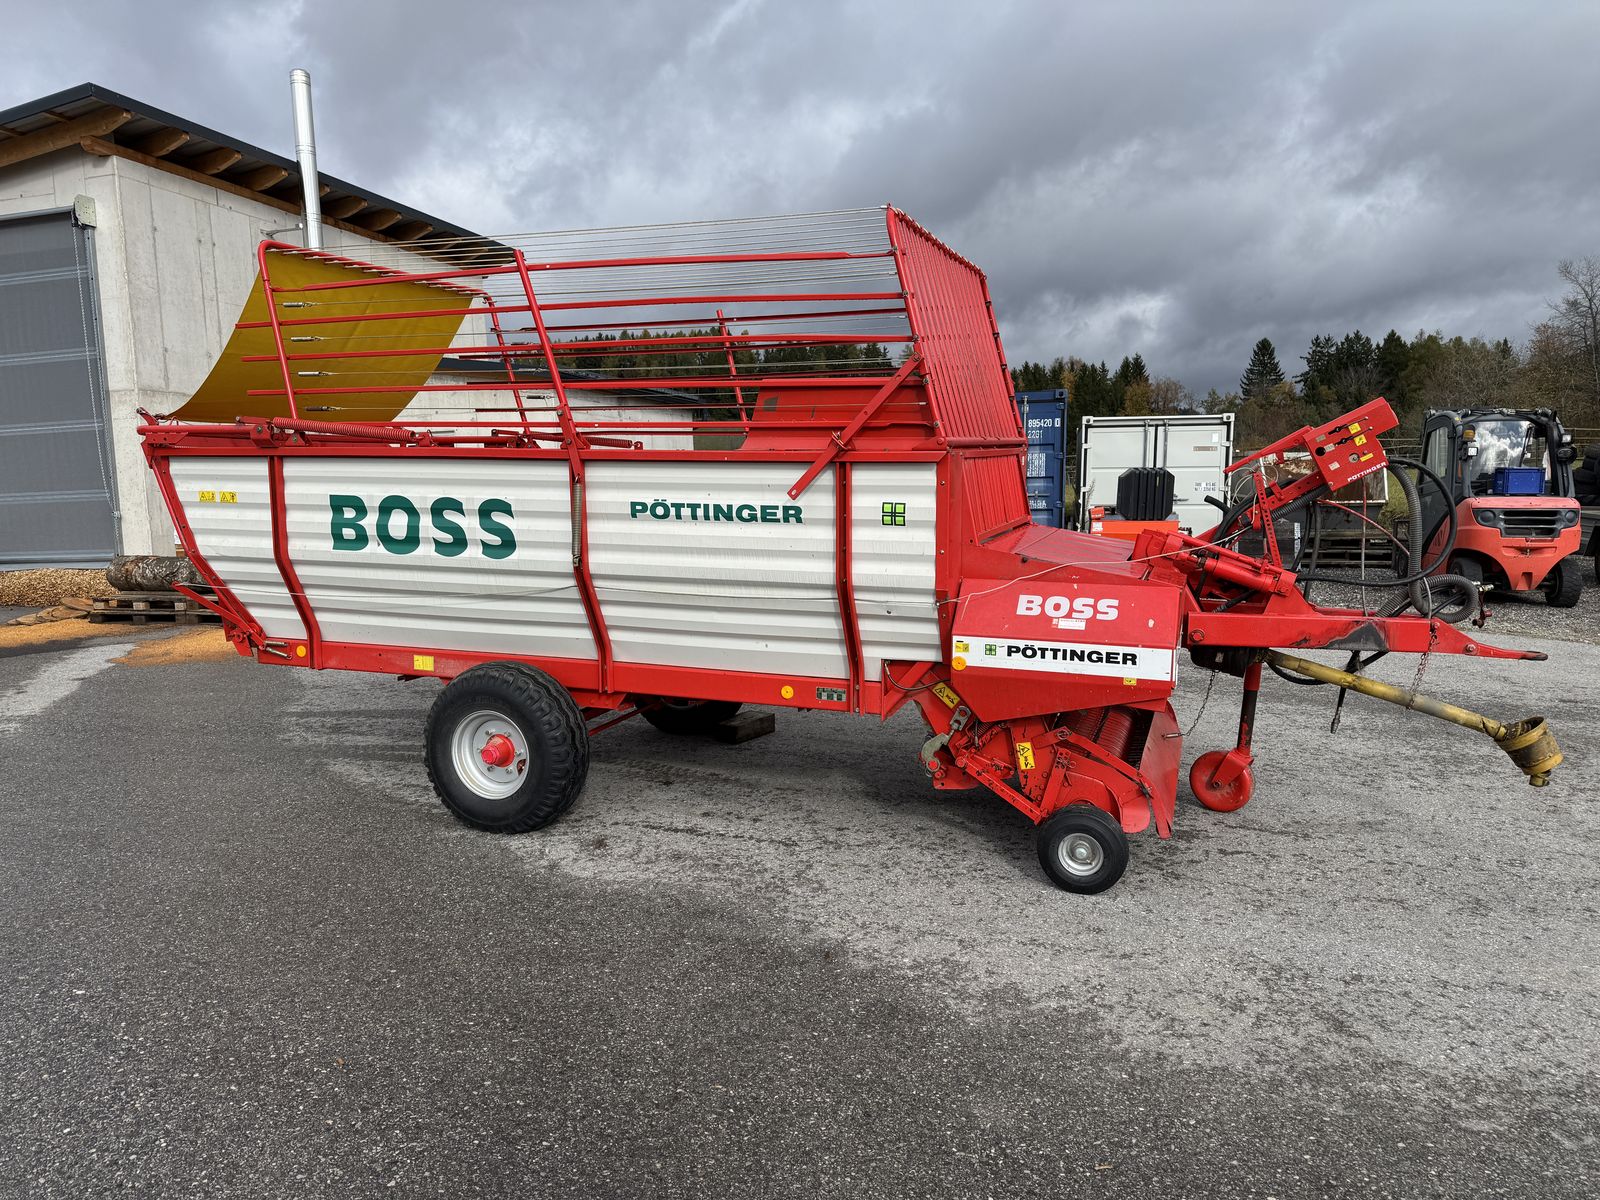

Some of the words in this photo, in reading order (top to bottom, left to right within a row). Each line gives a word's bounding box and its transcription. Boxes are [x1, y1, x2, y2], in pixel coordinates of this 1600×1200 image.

[1028, 419, 1052, 428] 895420
[630, 499, 804, 524] PÖTTINGER
[329, 494, 517, 560] BOSS
[1016, 594, 1119, 621] BOSS
[1006, 644, 1138, 666] PÖTTINGER
